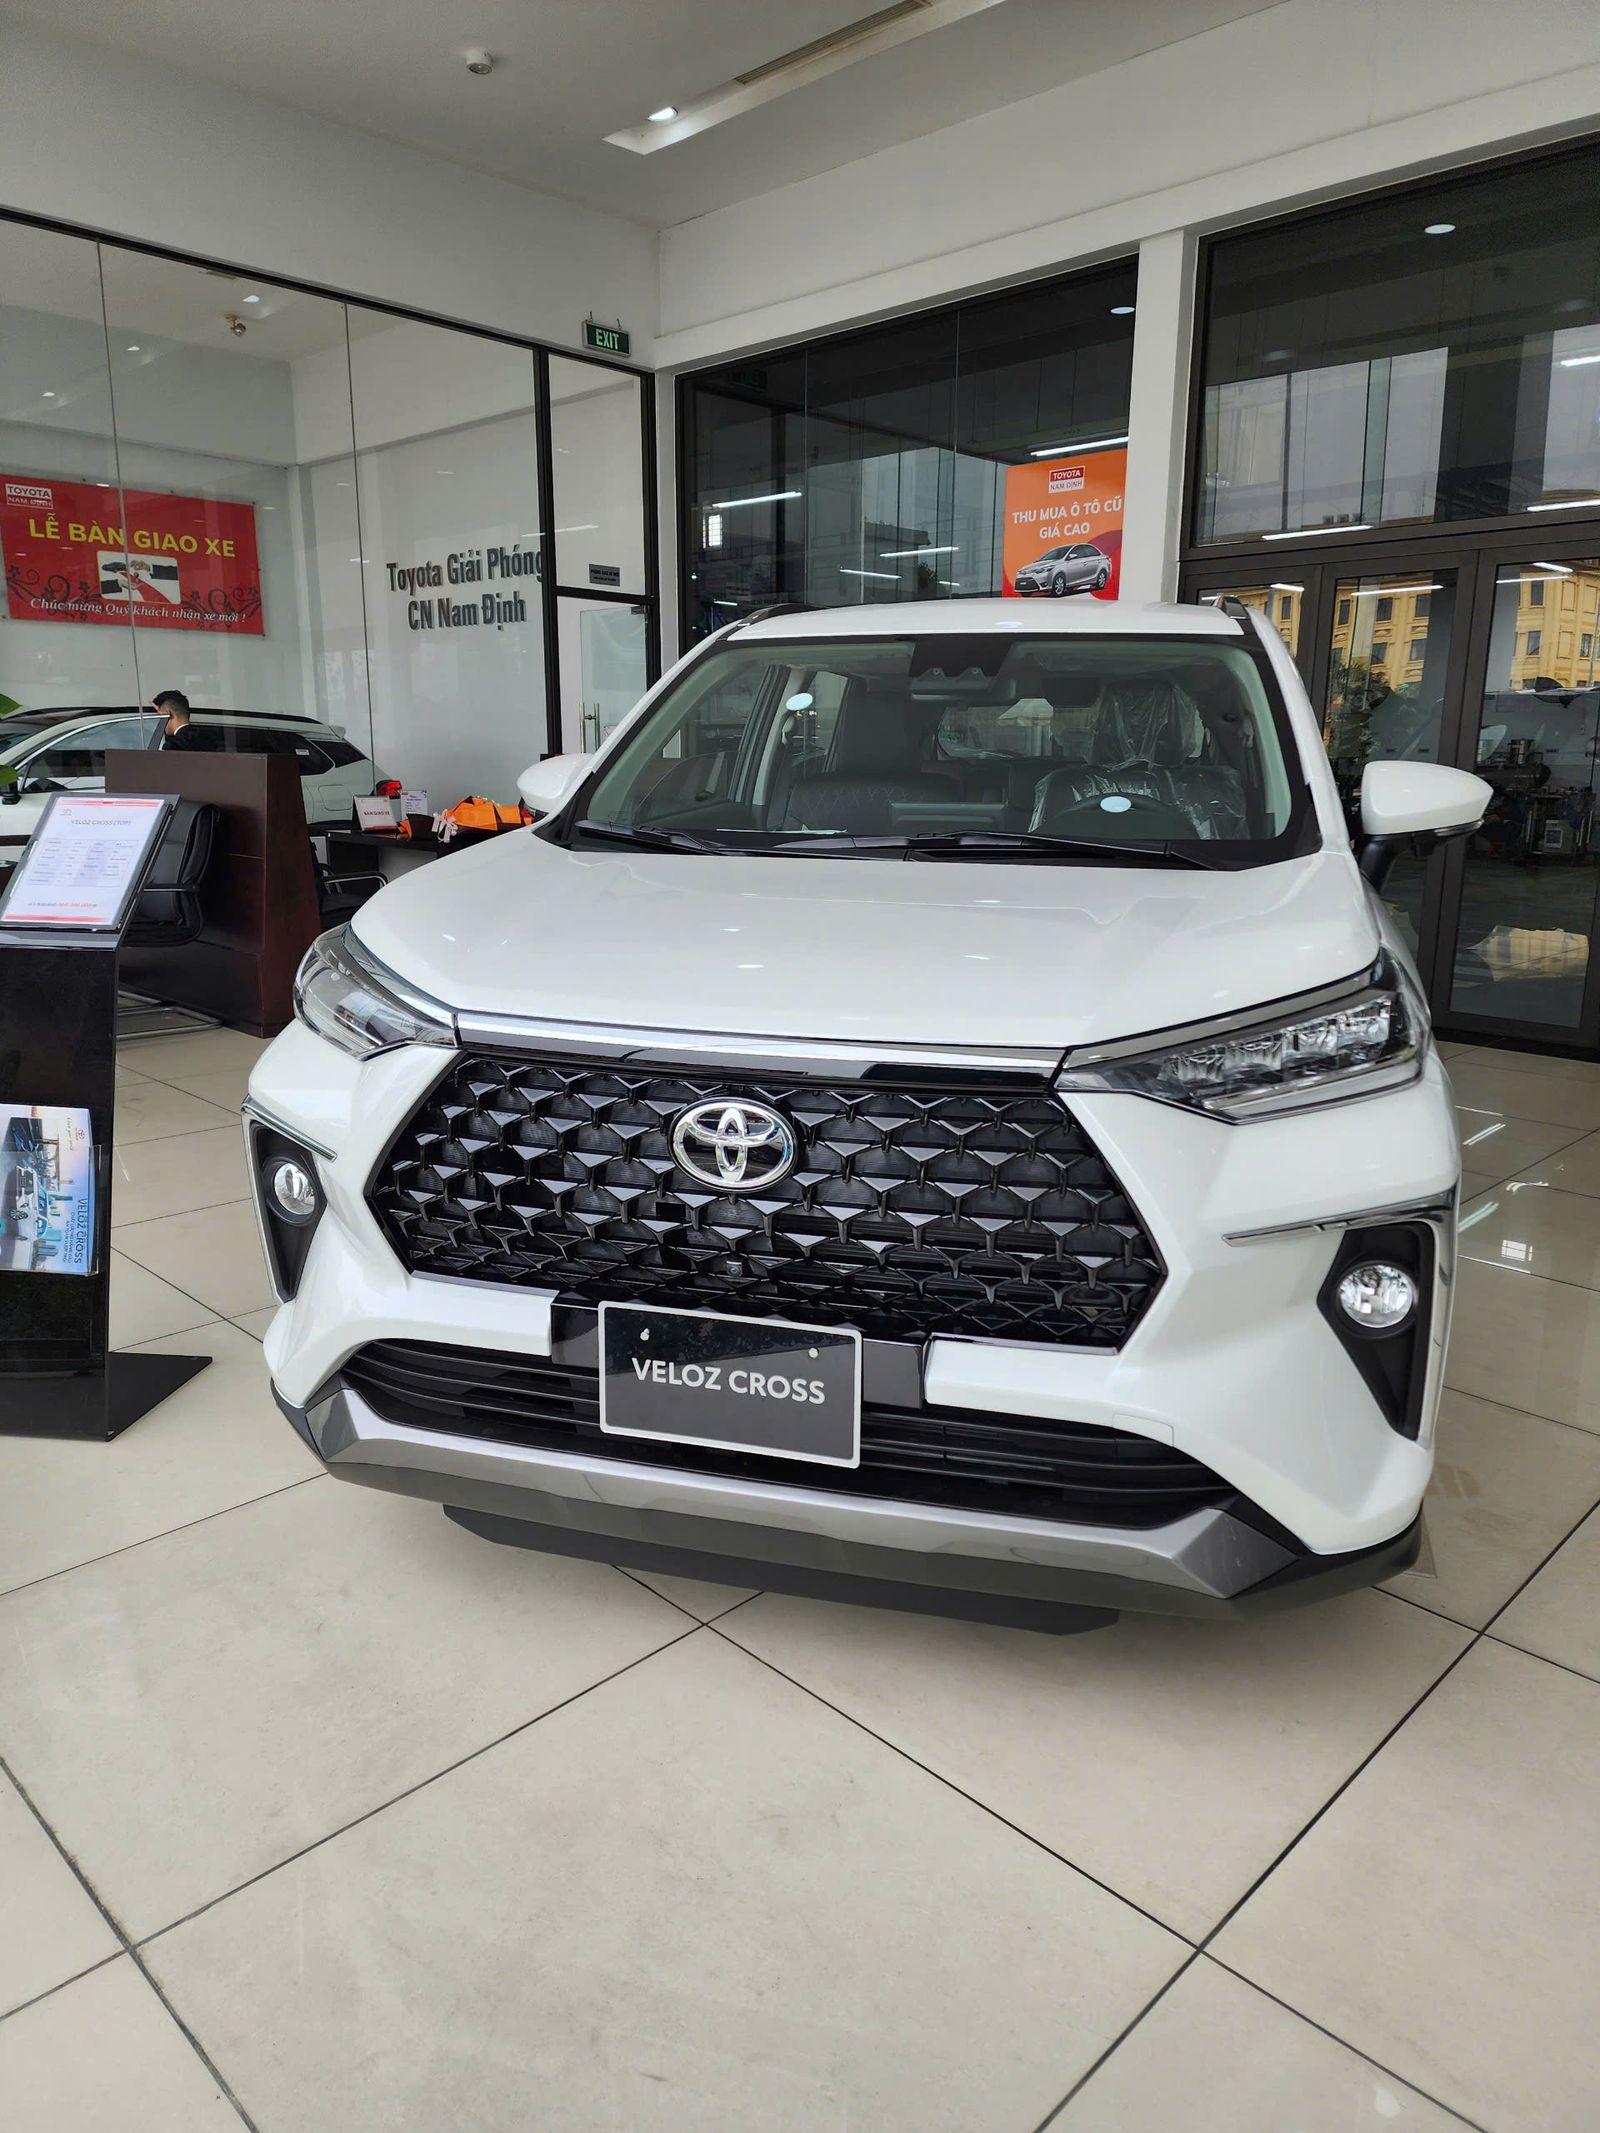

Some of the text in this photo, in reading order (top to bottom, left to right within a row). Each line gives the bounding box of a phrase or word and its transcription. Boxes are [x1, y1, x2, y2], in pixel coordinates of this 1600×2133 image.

[596, 328, 620, 350] EXIT
[1050, 483, 1065, 491] NAM
[1052, 469, 1081, 481] TOYOTA
[8, 486, 50, 498] TOYOTA
[1012, 496, 1123, 524] THU MUA Ô TÔ CŨ
[29, 512, 236, 558] LỄ BÀN GIAO XE
[1039, 522, 1090, 539] GIÁ CAO
[387, 560, 442, 595] Toyota
[447, 549, 483, 585] Giải
[30, 596, 64, 611] Chúc
[133, 604, 169, 618] khách
[172, 607, 200, 621] nhận
[219, 611, 239, 623] mới
[407, 591, 527, 631] CN Nam Định
[74, 1198, 88, 1264] VELOZ CROSS
[631, 1357, 825, 1405] VELOZ CROSS
